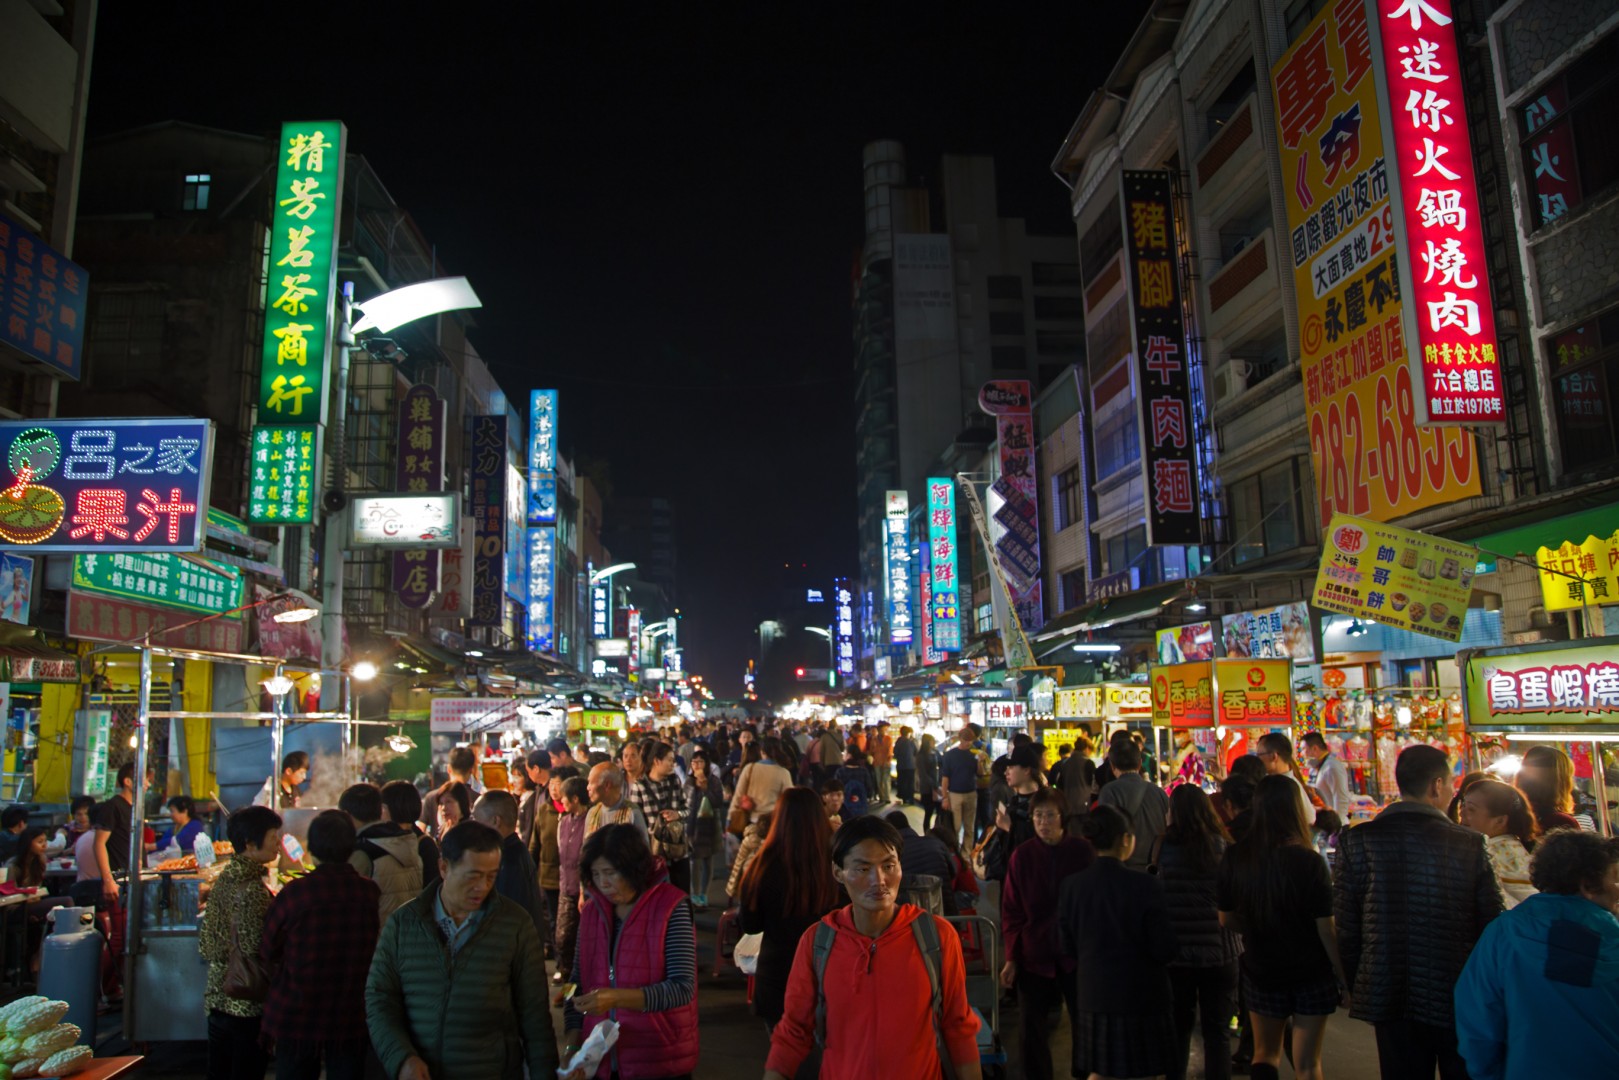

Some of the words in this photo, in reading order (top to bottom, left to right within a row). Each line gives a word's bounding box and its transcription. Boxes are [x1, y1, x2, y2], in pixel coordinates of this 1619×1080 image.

[1292, 158, 1388, 267] 國際觀光夜市
[267, 130, 332, 416] 精芳茗茶商行
[1425, 342, 1495, 365] 附素食火鍋
[1432, 368, 1494, 392] 六合總店
[1145, 335, 1194, 514] 牛肉麵
[1431, 396, 1502, 414] 創立於1978年
[64, 429, 200, 480] 呂之家
[475, 417, 503, 476] 大力
[295, 431, 313, 519] 阿里山烏龍茶
[70, 488, 196, 542] 果汁
[1338, 527, 1363, 552] 鄭
[1366, 545, 1396, 610] 帥哥餅
[1543, 553, 1597, 581] 平口褲
[1567, 576, 1609, 601] 專賣
[1248, 612, 1283, 638] 牛肉麵
[1171, 677, 1211, 716] 香酥雞
[1222, 690, 1287, 720] 香酥雞
